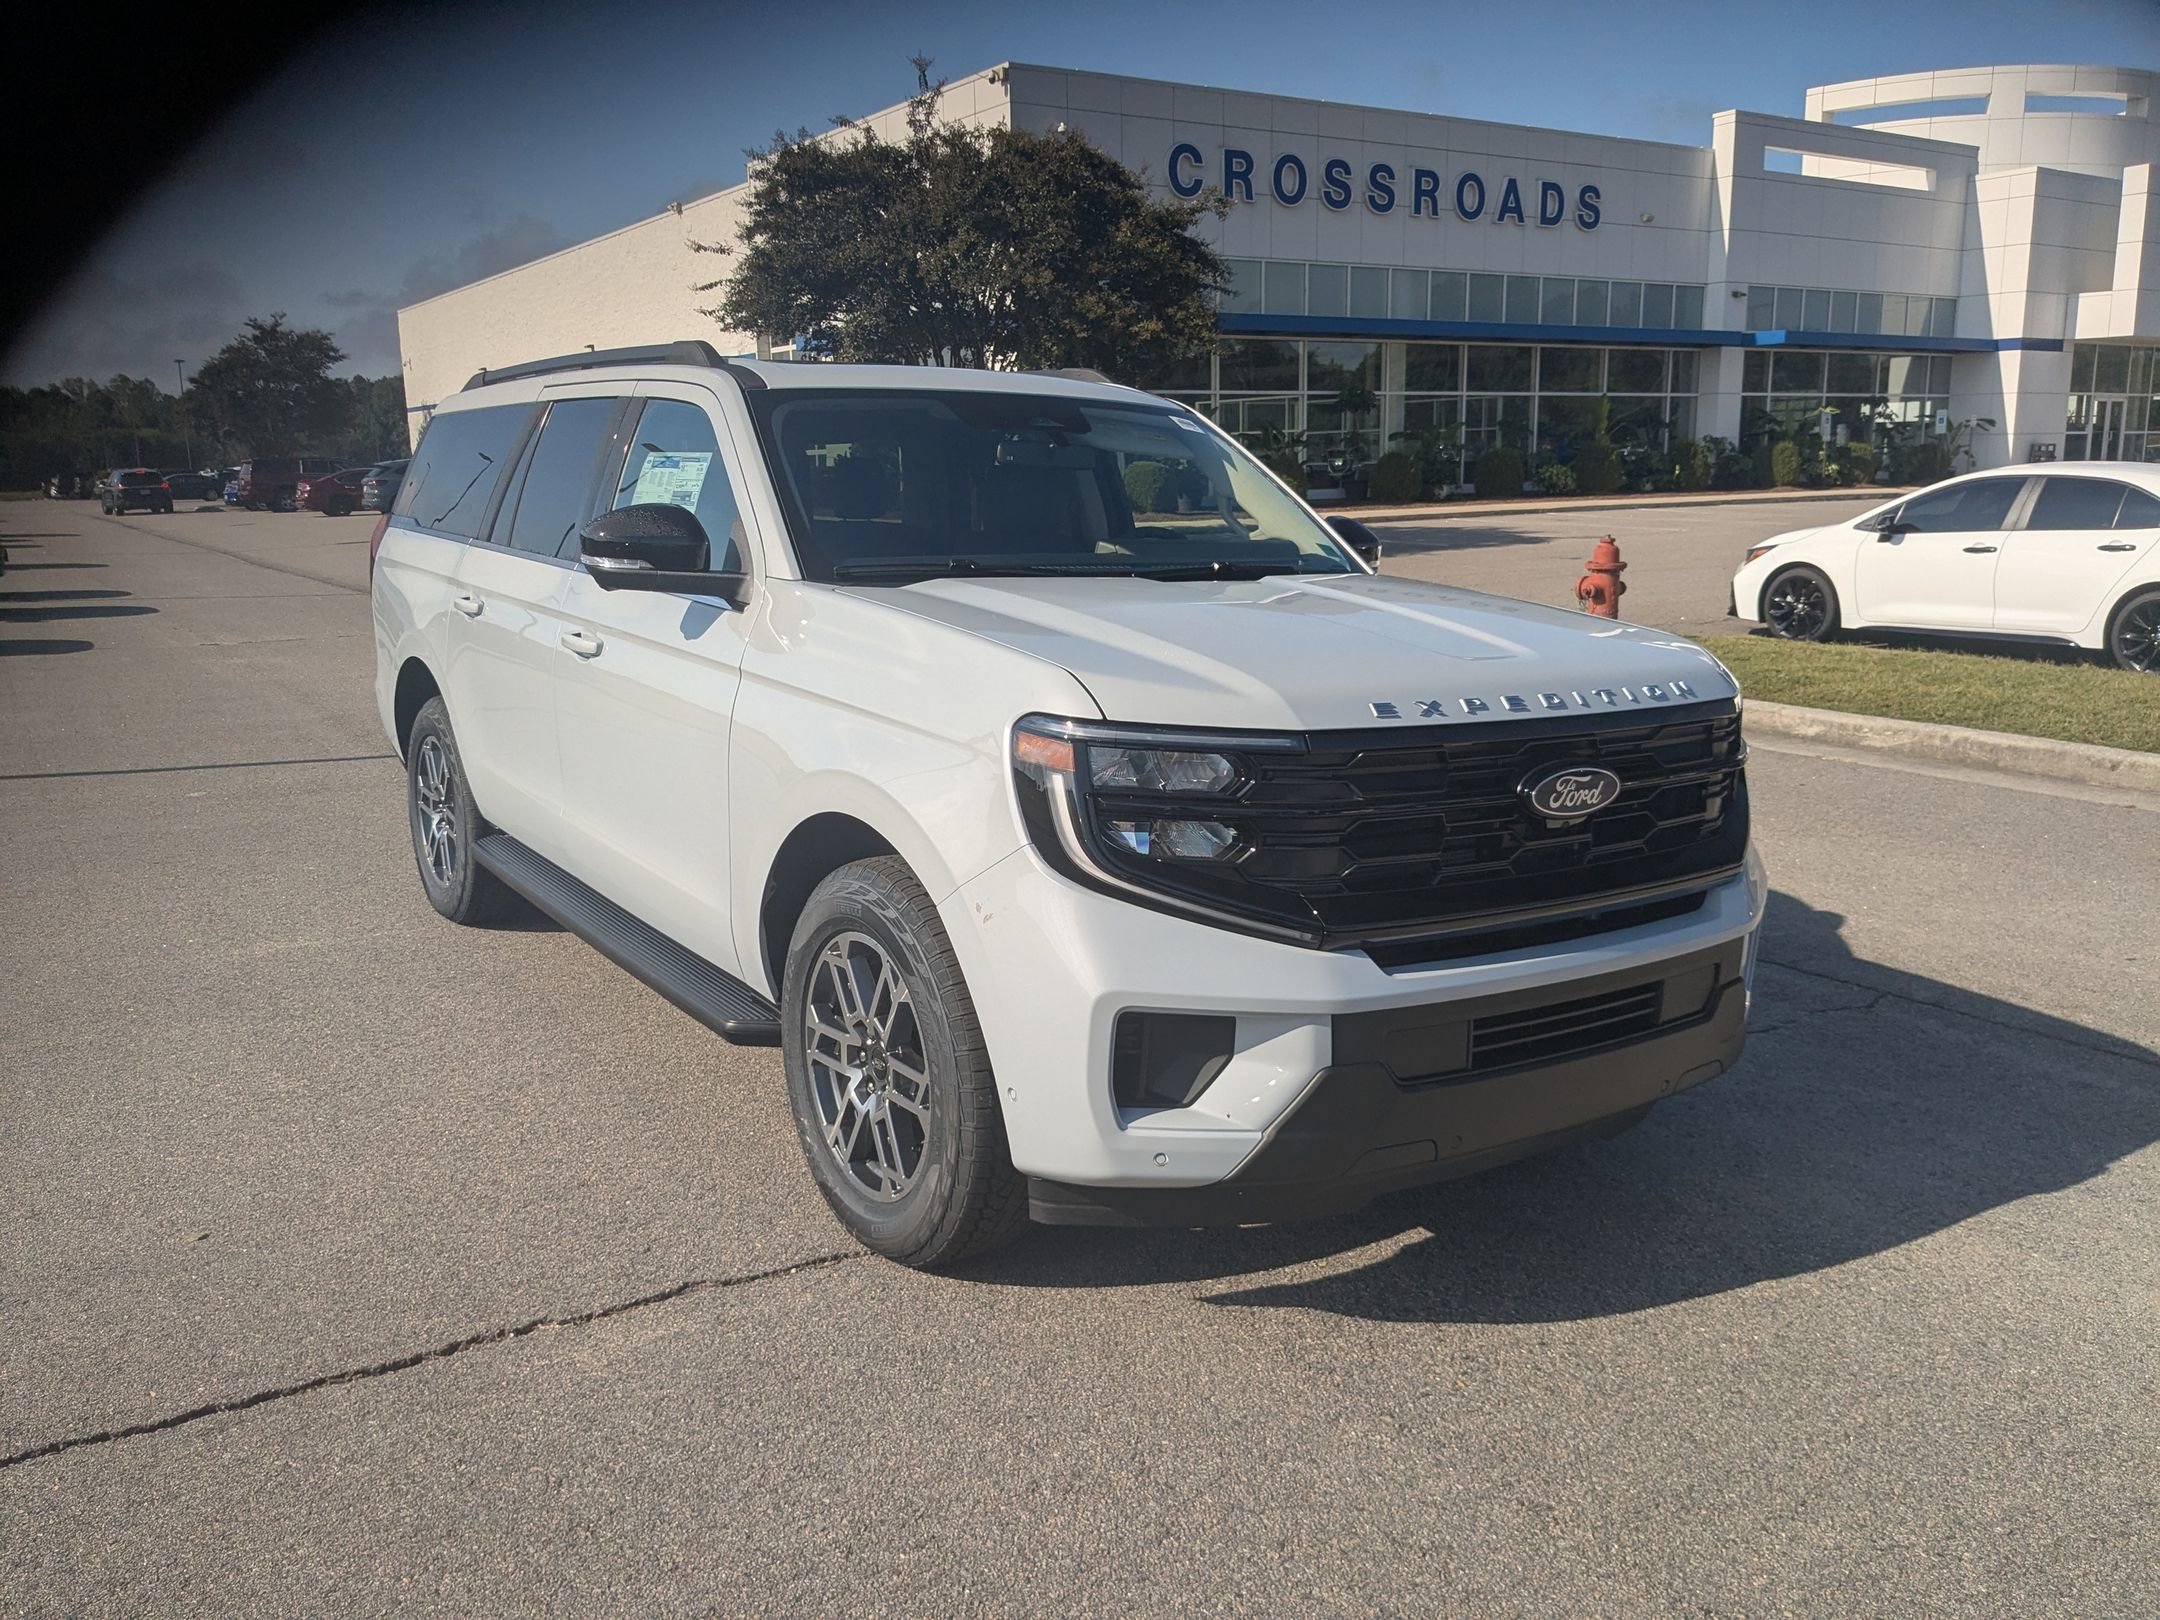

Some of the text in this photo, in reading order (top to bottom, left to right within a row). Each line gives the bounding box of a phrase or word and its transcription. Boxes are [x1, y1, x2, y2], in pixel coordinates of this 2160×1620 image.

[1167, 142, 1602, 232] CROSSROADS
[1368, 680, 1697, 719] EXPEDITION
[1549, 775, 1604, 808] Ford
